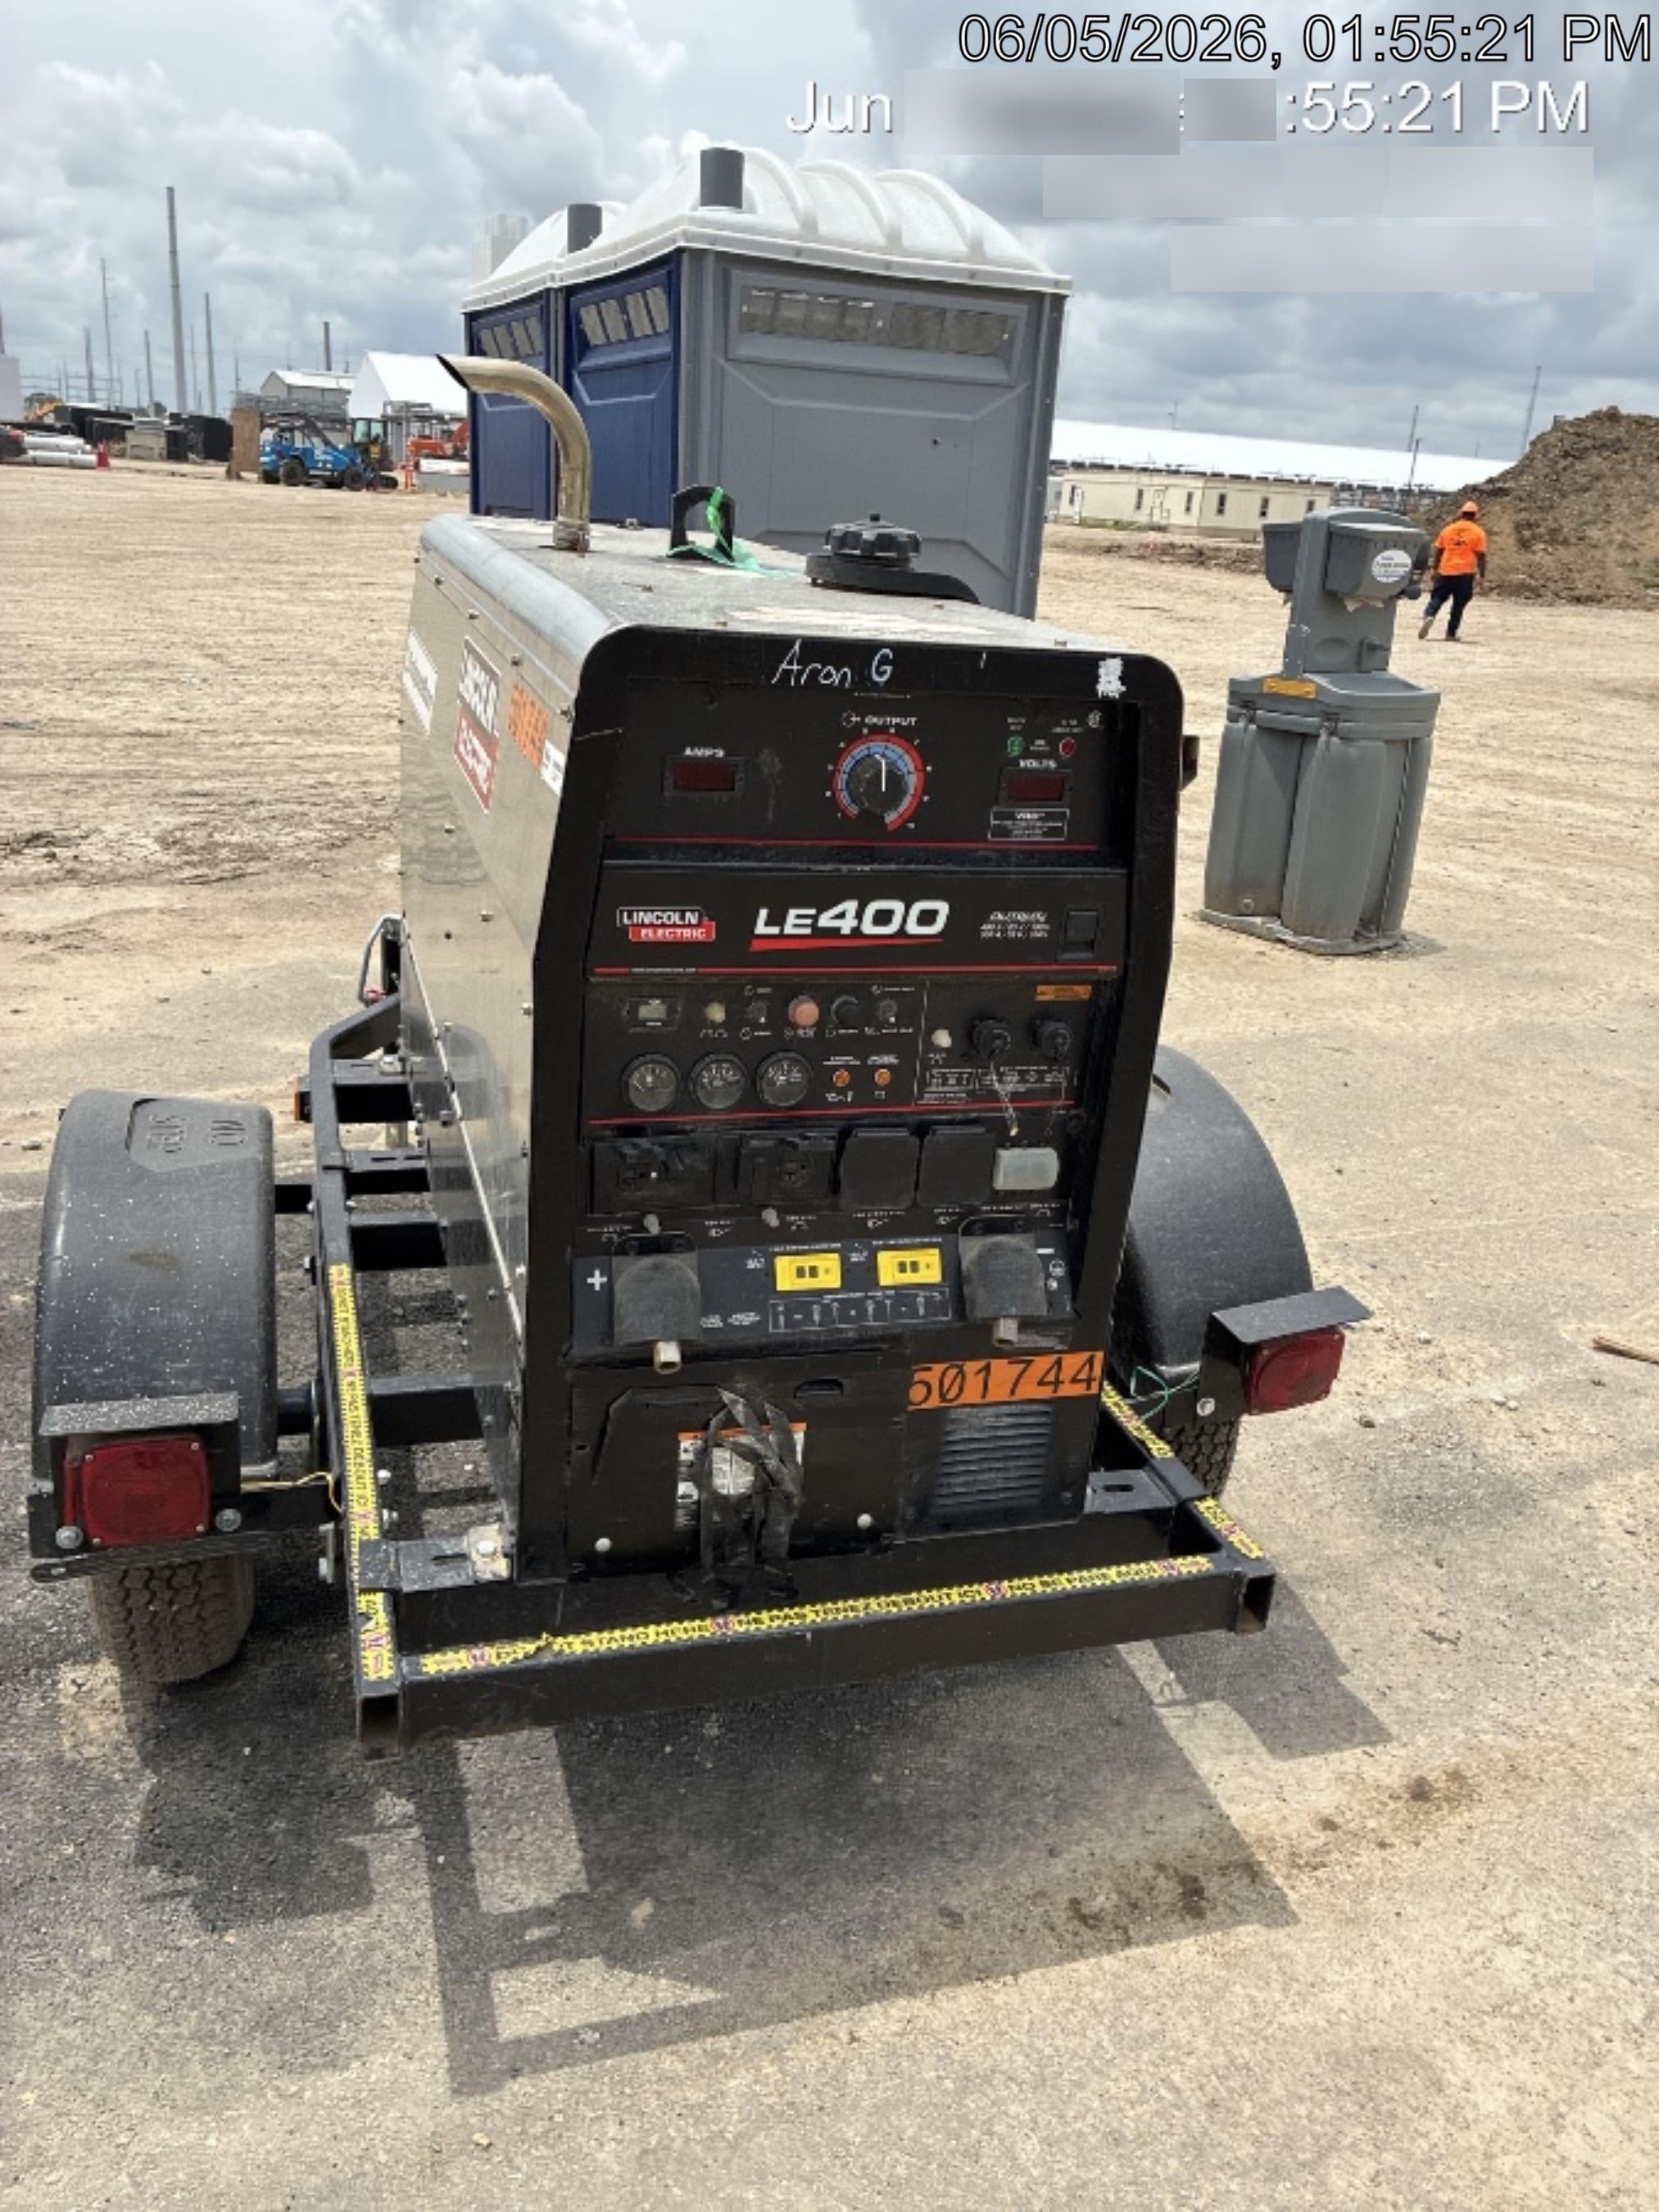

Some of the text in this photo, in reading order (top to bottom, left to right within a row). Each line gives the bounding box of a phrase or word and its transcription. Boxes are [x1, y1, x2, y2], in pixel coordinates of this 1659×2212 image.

[771, 638, 894, 688] Aron G
[864, 715, 918, 727] OUTPUT
[684, 746, 725, 758] AMPS
[623, 910, 700, 926] LINCOLN
[754, 900, 950, 936] LE400
[640, 927, 706, 940] ELECTRIC
[909, 1353, 1098, 1406] 501744
